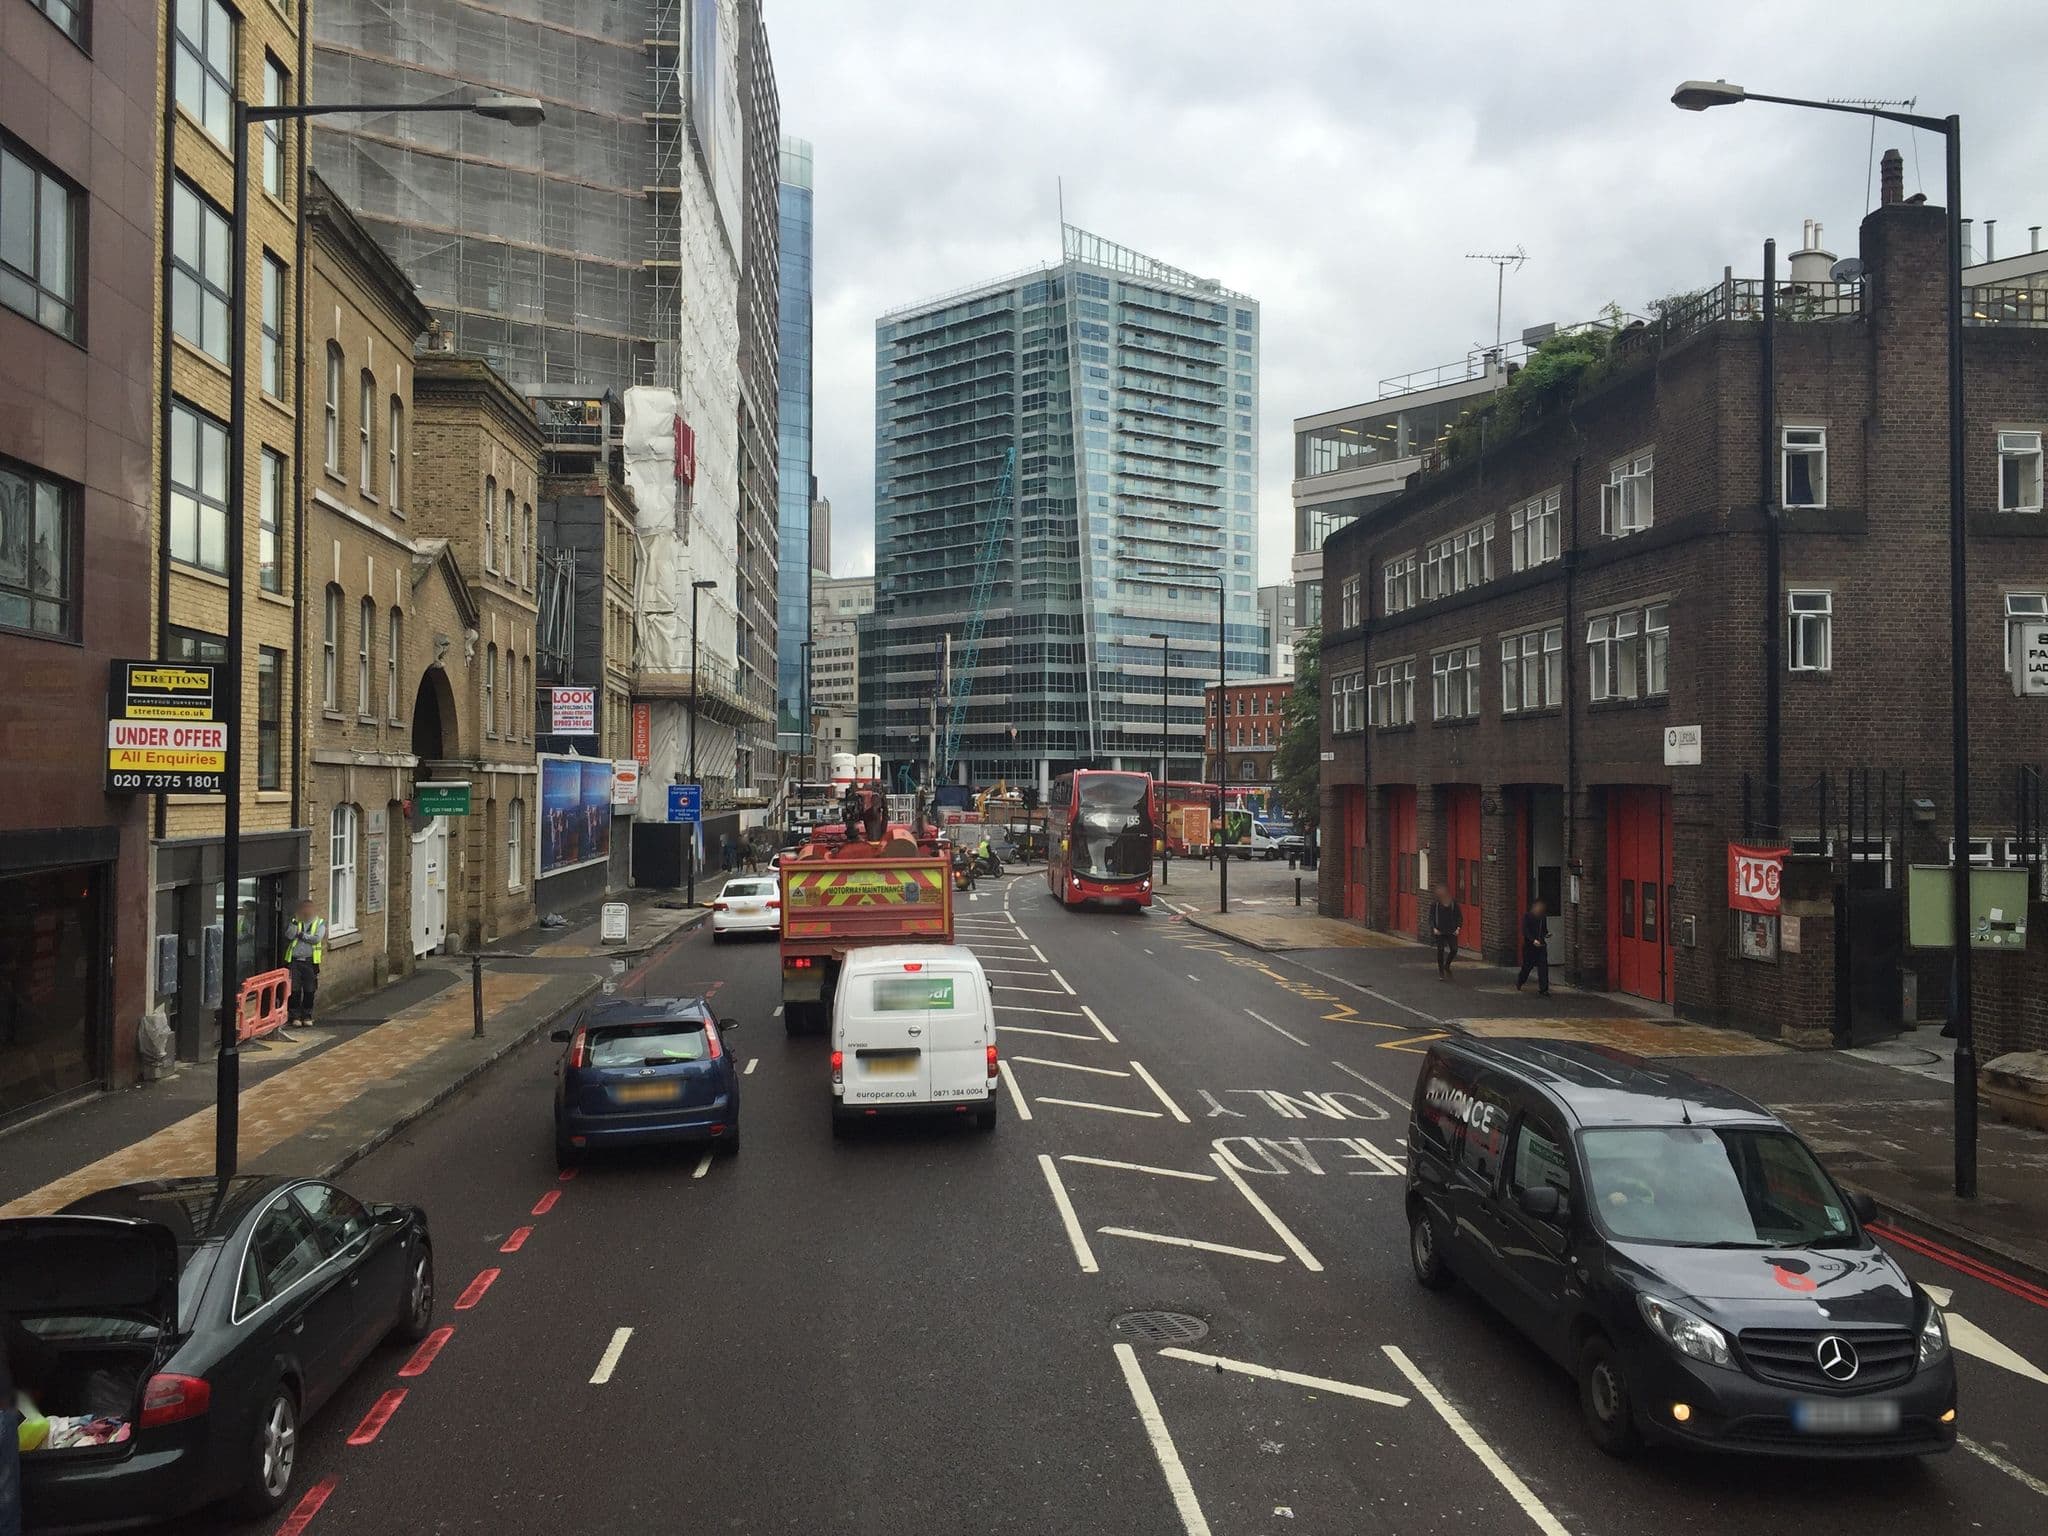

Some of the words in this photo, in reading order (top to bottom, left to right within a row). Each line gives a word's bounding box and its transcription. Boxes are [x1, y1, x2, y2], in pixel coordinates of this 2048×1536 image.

[134, 674, 206, 685] STRETTONS
[553, 691, 592, 704] LOOK
[133, 708, 205, 717] strettons.co.uk
[116, 726, 169, 746] UNDER
[173, 728, 222, 748] OFFER
[120, 751, 140, 763] All
[146, 752, 217, 766] Enquiries
[113, 775, 141, 787] 020
[145, 775, 181, 788] 7375
[186, 776, 221, 788] 1801
[1127, 815, 1140, 825] 135
[1741, 862, 1779, 896] 150
[828, 886, 861, 895] MOTORWAY
[862, 885, 904, 894] MAINTENANCE
[856, 1089, 918, 1100] europcar.co.uk
[967, 1088, 983, 1096] 0004
[1196, 1089, 1391, 1121] ONLY
[1211, 1136, 1407, 1177] HEAD
